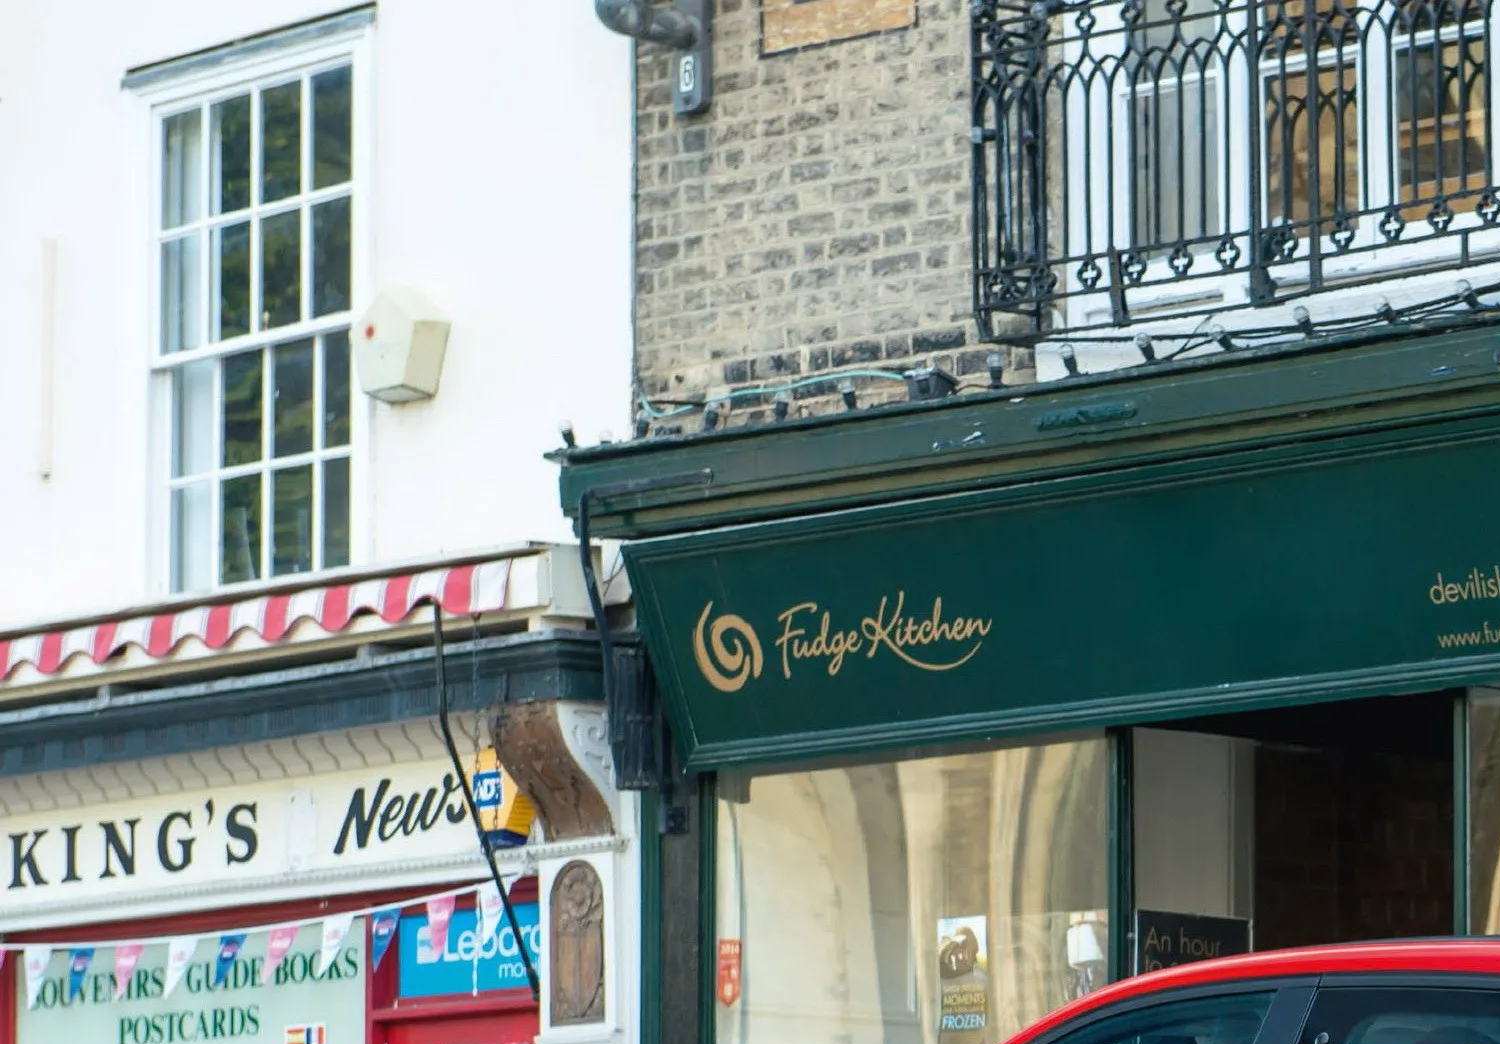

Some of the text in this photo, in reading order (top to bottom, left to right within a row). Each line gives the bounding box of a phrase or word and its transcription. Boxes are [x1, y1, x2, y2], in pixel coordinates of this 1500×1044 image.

[775, 590, 993, 680] Fudge Kitchen
[8, 772, 468, 890] KING'S News
[1144, 925, 1222, 957] An hour
[942, 1012, 986, 1030] FROZEN
